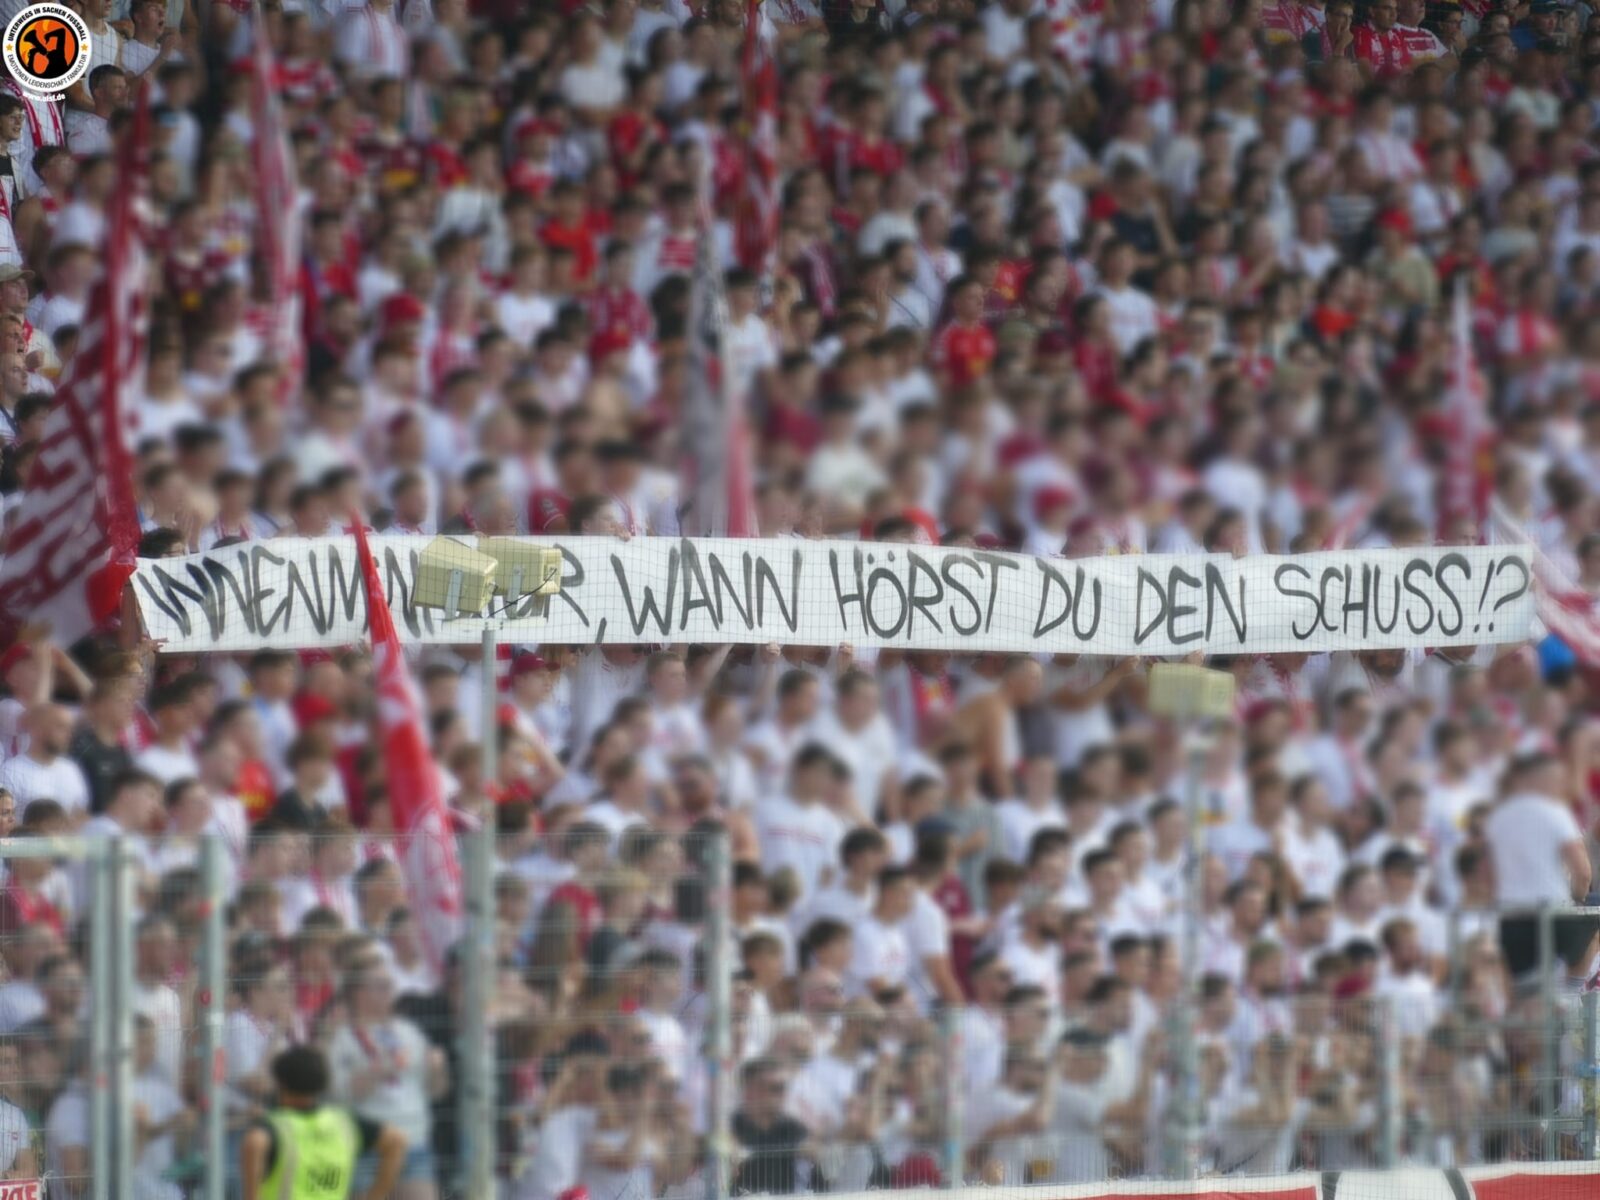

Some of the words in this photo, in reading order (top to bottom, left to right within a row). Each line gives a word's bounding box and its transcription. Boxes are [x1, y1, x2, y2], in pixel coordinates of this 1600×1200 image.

[609, 538, 803, 636] WANN
[829, 545, 1020, 640] HÖRST
[1032, 557, 1101, 641] DU
[1133, 562, 1246, 645] DEN
[1272, 552, 1531, 640] SCHUSS!?
